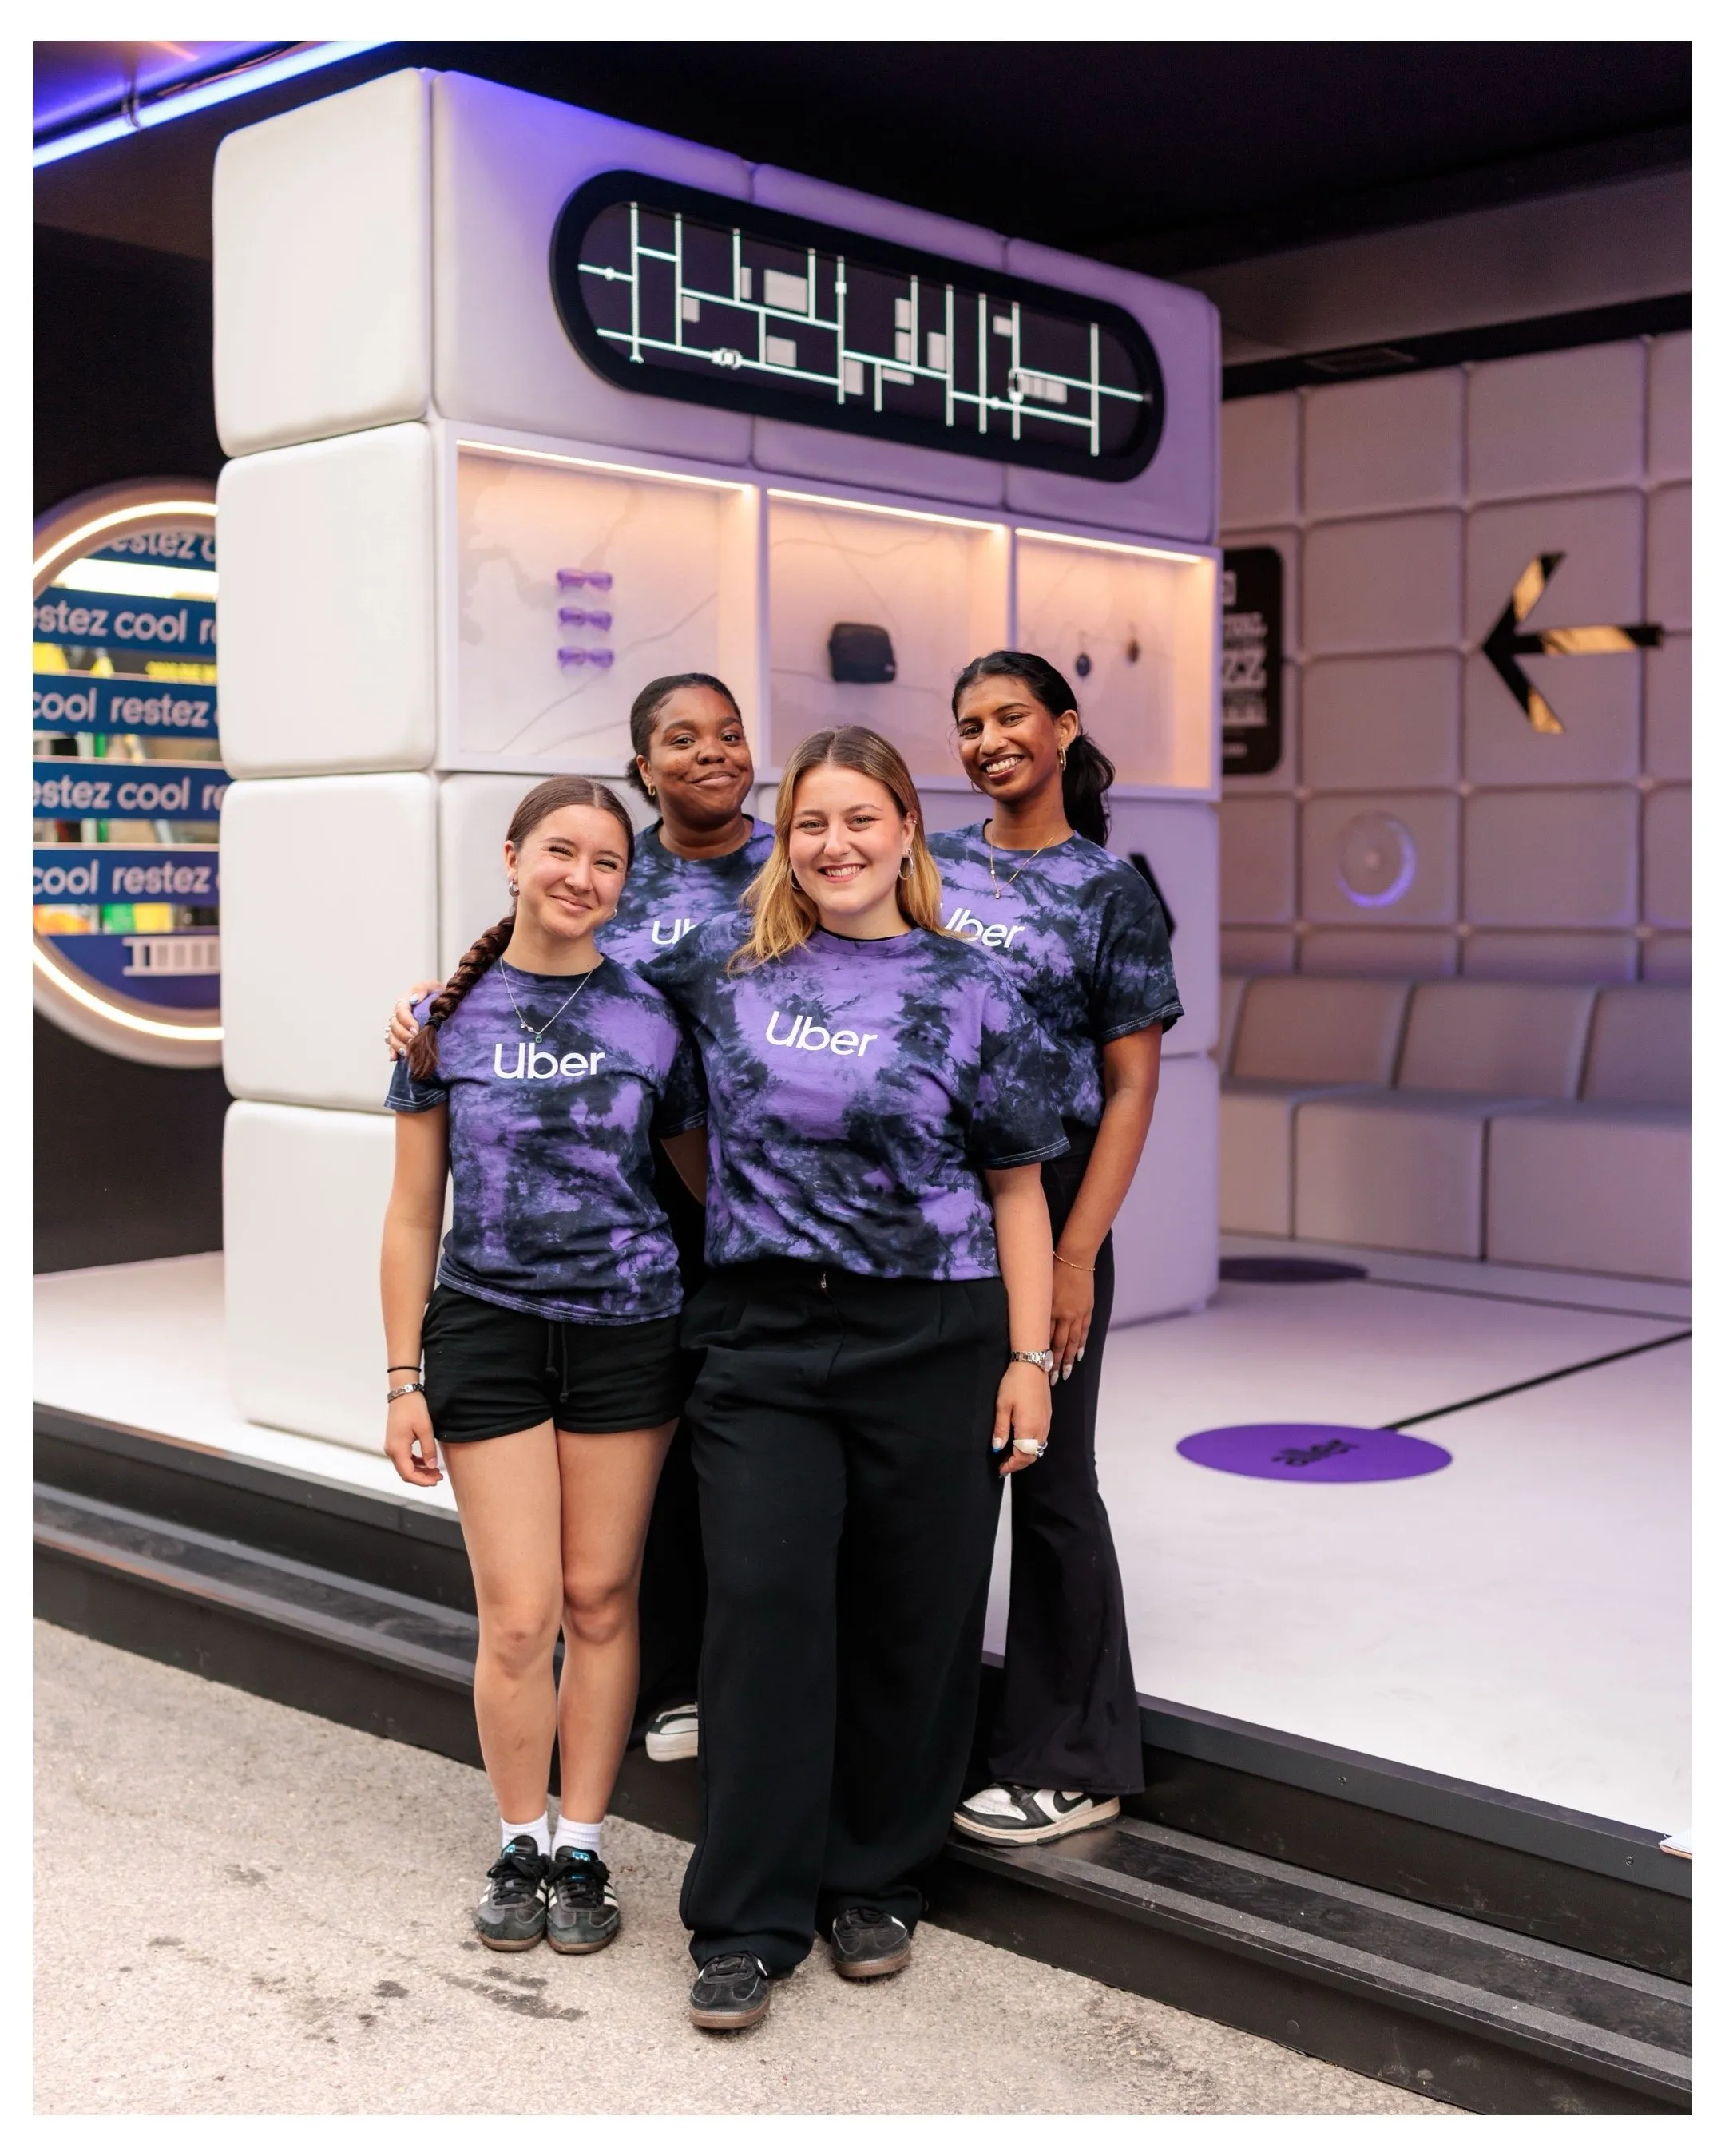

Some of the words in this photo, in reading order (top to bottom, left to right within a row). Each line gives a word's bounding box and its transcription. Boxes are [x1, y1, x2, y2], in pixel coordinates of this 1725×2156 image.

[114, 608, 188, 643] cool
[110, 692, 210, 727] restez
[117, 776, 191, 810] cool
[113, 861, 212, 894] restez
[766, 1011, 878, 1057] Uber
[494, 1042, 605, 1079] Uber
